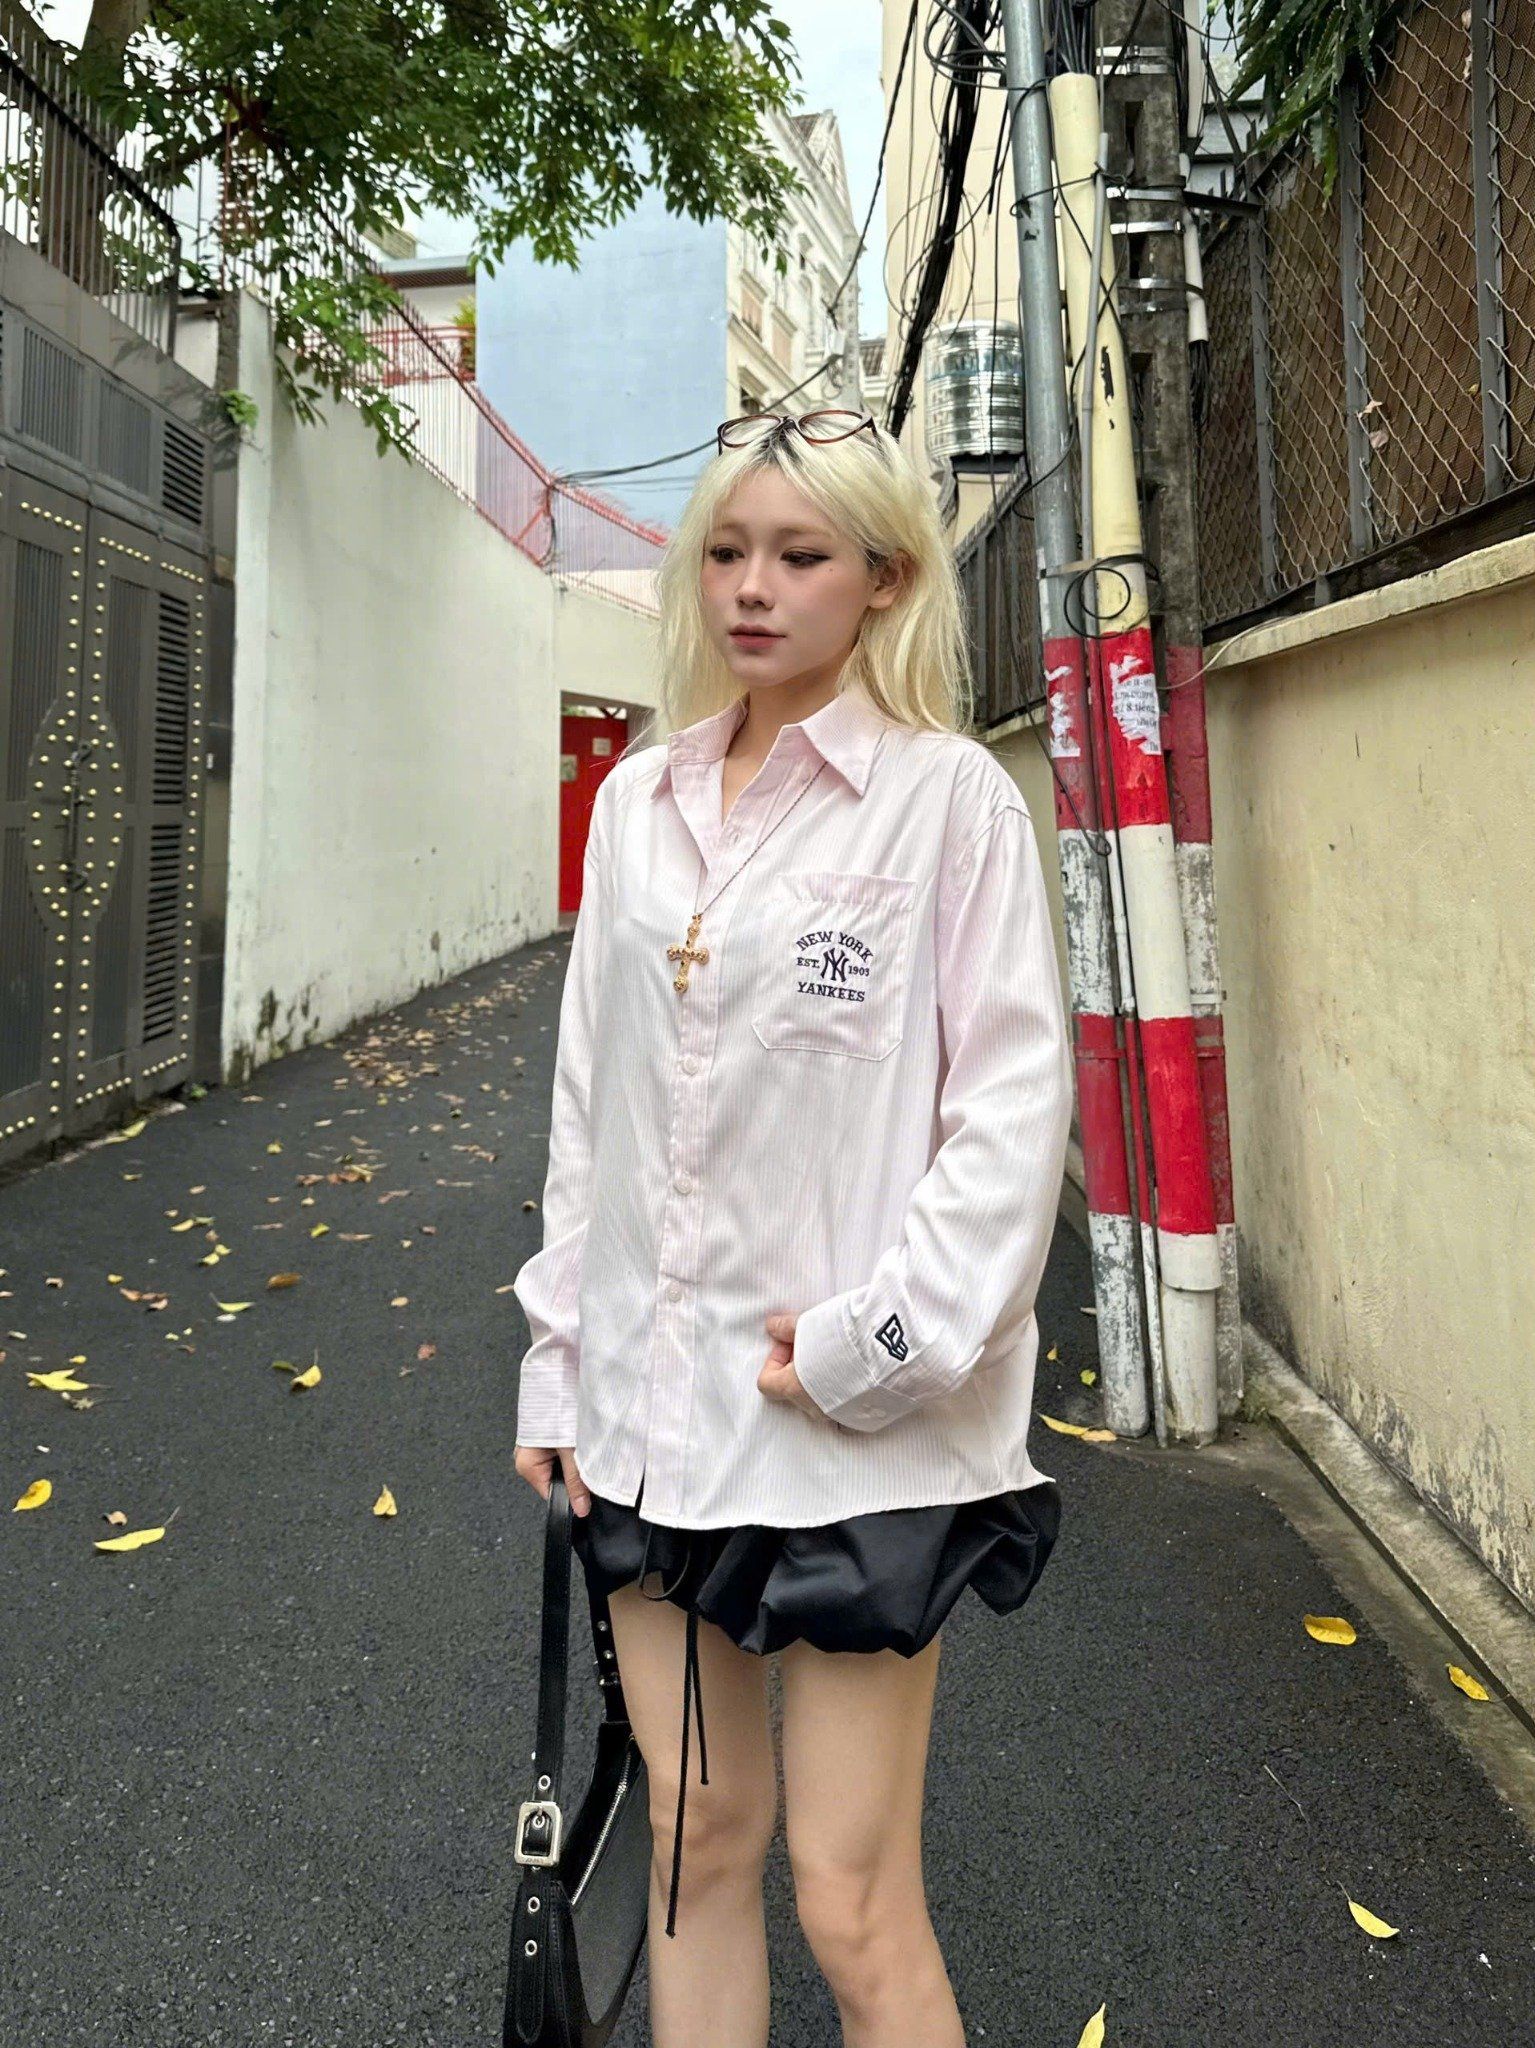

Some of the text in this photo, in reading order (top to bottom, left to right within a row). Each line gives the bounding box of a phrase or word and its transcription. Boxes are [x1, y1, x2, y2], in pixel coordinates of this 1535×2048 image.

[796, 931, 874, 963] NEW YORK
[796, 957, 820, 969] EST.
[848, 965, 870, 977] 1903
[797, 981, 865, 1002] YANKEES
